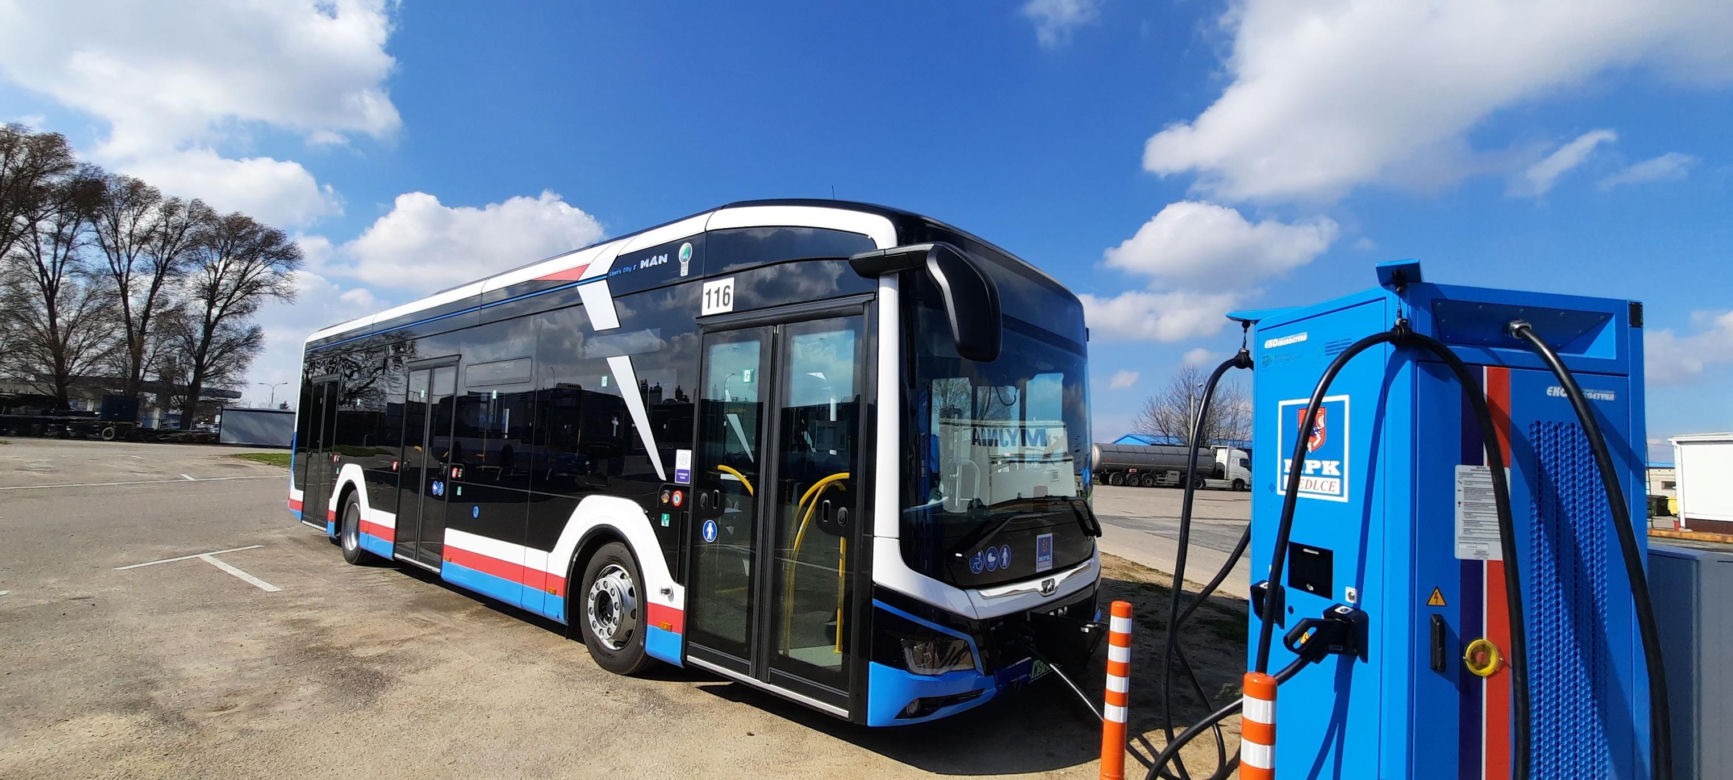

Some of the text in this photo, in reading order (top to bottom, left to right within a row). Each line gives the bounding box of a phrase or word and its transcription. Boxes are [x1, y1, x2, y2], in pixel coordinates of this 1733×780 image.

[640, 253, 668, 269] MAN
[705, 285, 731, 310] 116
[1295, 478, 1337, 493] EDLCE
